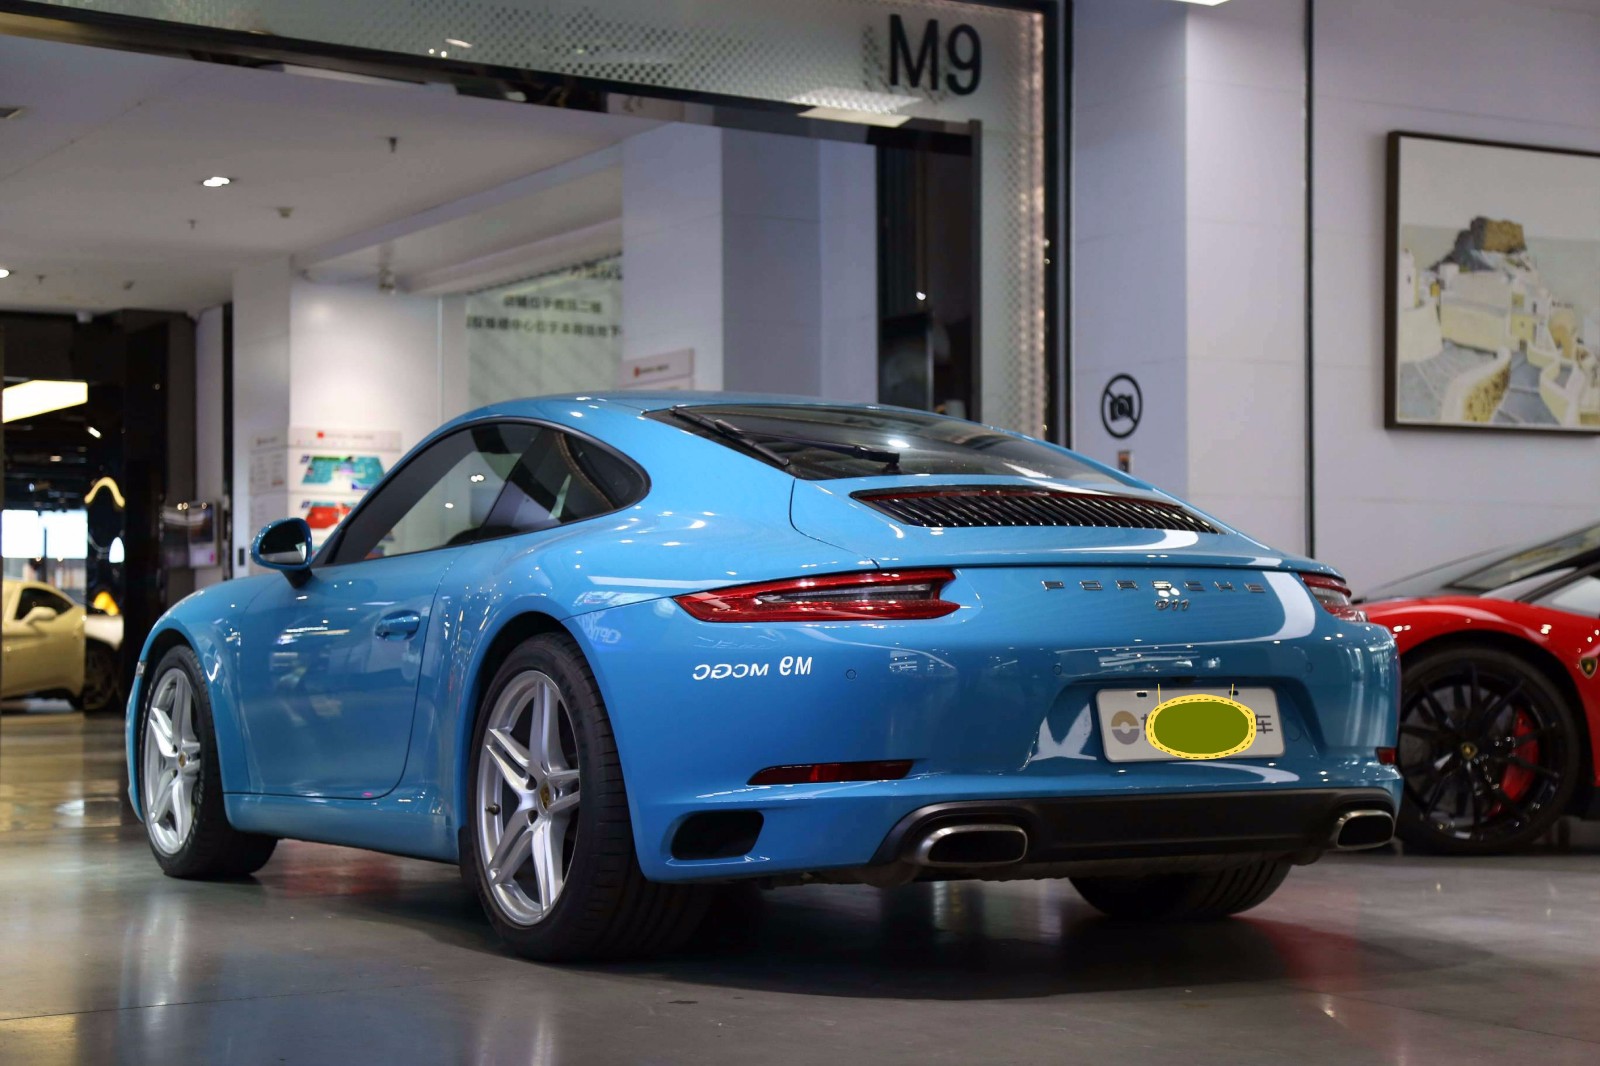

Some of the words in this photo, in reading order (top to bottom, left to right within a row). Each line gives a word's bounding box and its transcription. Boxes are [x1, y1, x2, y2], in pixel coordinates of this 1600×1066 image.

[889, 13, 981, 96] M9
[1041, 580, 1265, 593] PORSCHE
[1155, 598, 1189, 611] 911
